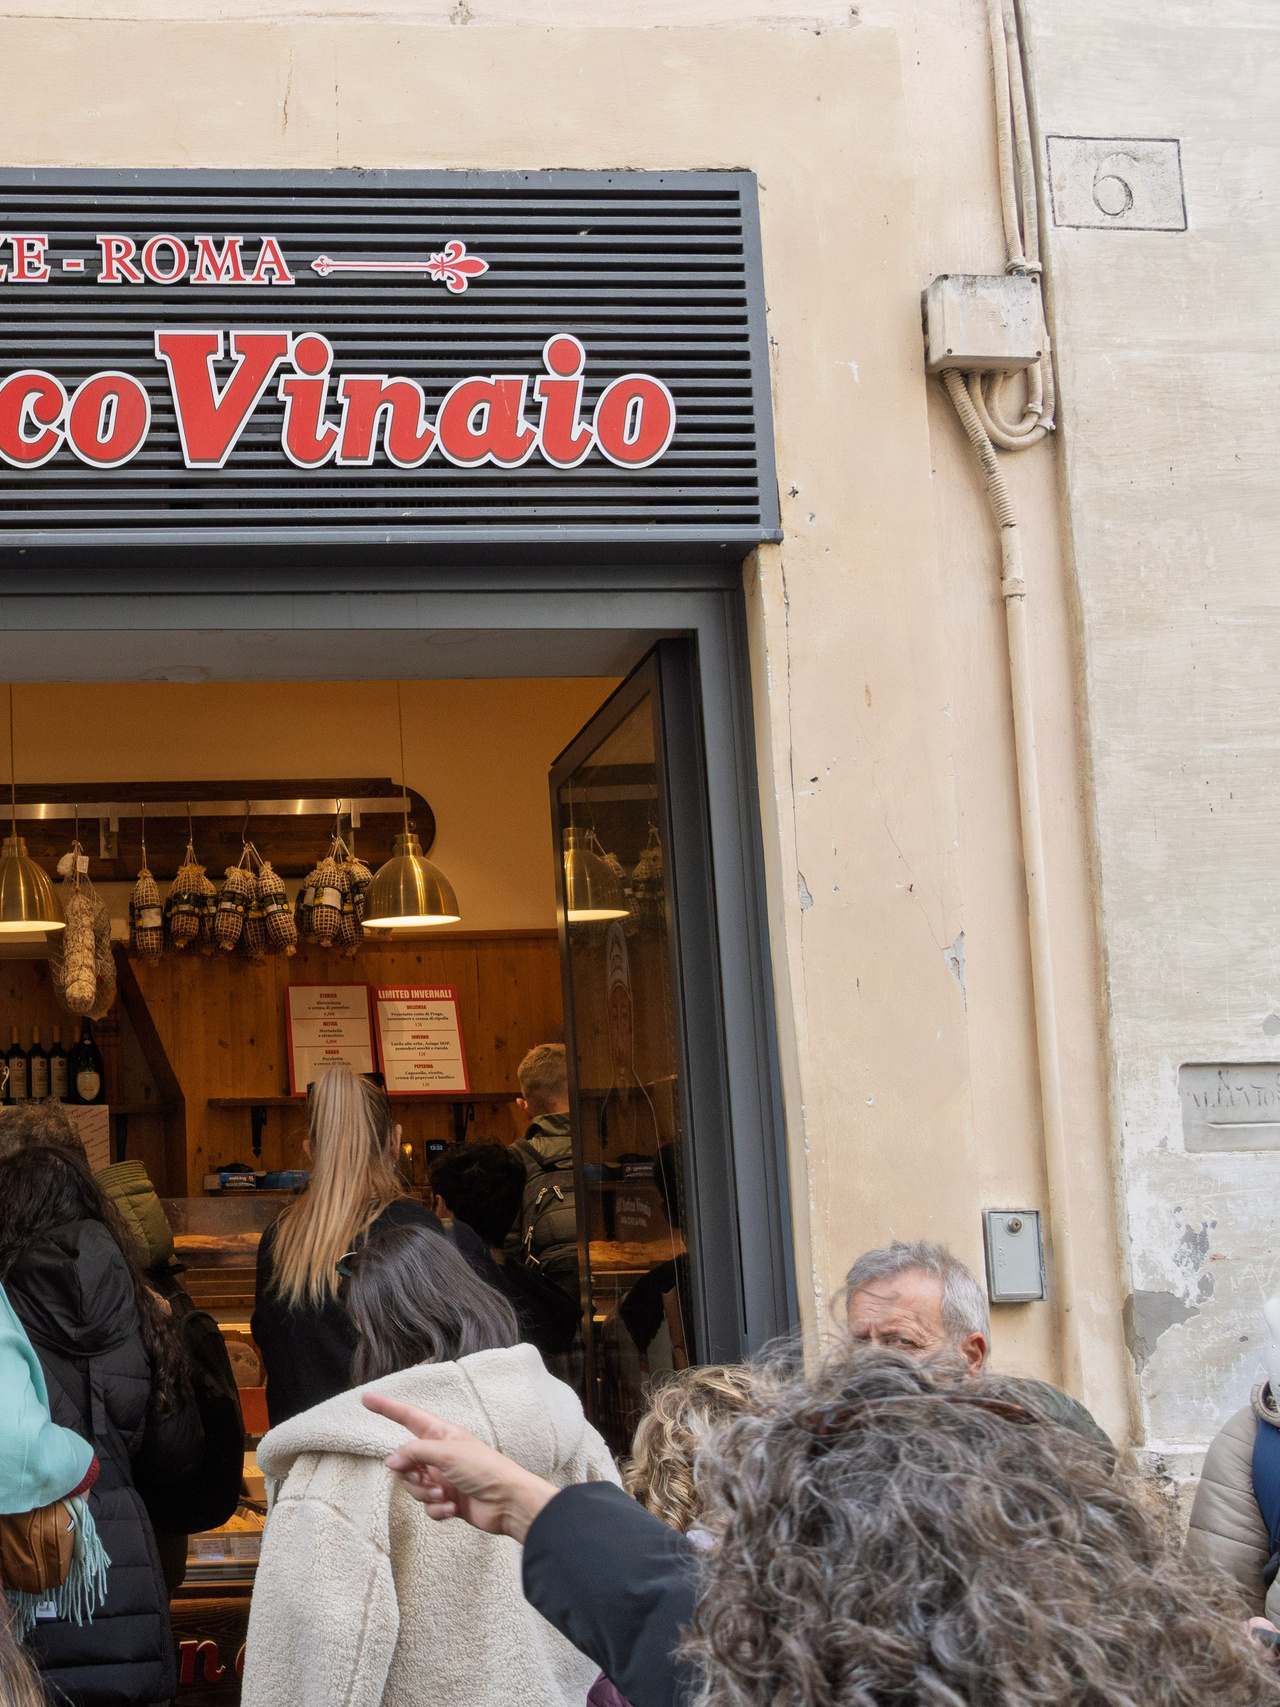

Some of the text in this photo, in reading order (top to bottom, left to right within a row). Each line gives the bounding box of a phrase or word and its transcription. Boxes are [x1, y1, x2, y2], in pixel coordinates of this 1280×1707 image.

[96, 234, 296, 285] ROMA
[154, 329, 677, 469] Vinaio
[378, 989, 452, 998] LIMITED INVERNALI
